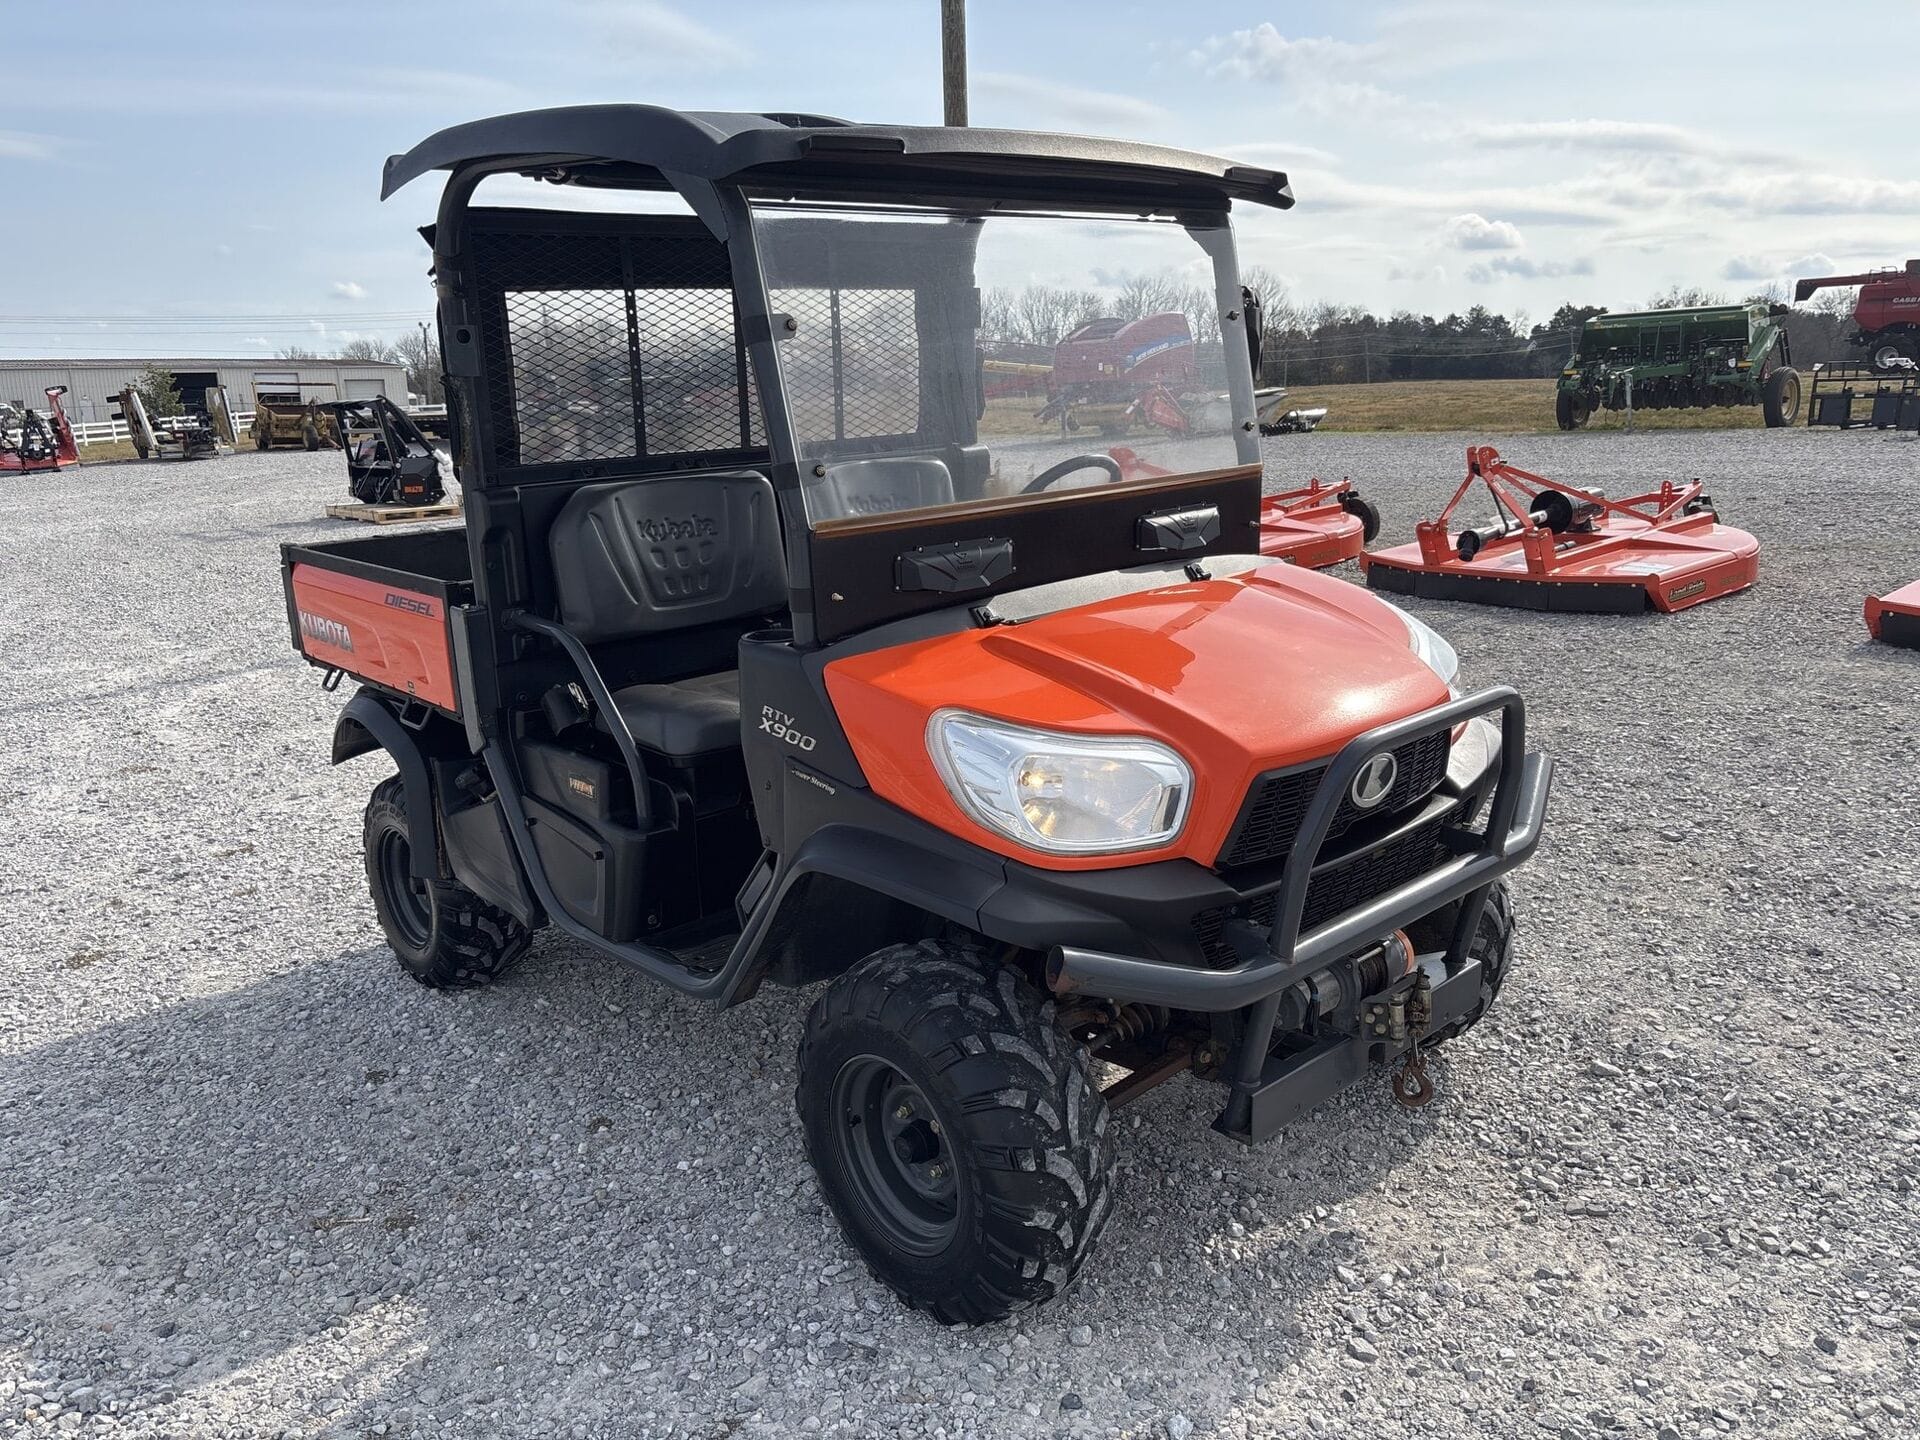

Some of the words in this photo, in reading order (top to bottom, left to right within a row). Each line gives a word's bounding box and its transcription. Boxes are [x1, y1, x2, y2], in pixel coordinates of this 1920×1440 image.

[637, 514, 718, 543] Kubota
[383, 593, 435, 617] DIESEL
[299, 610, 354, 653] KUBOTA
[761, 705, 795, 726] RTV
[758, 716, 817, 751] X900
[811, 776, 836, 796] Steering
